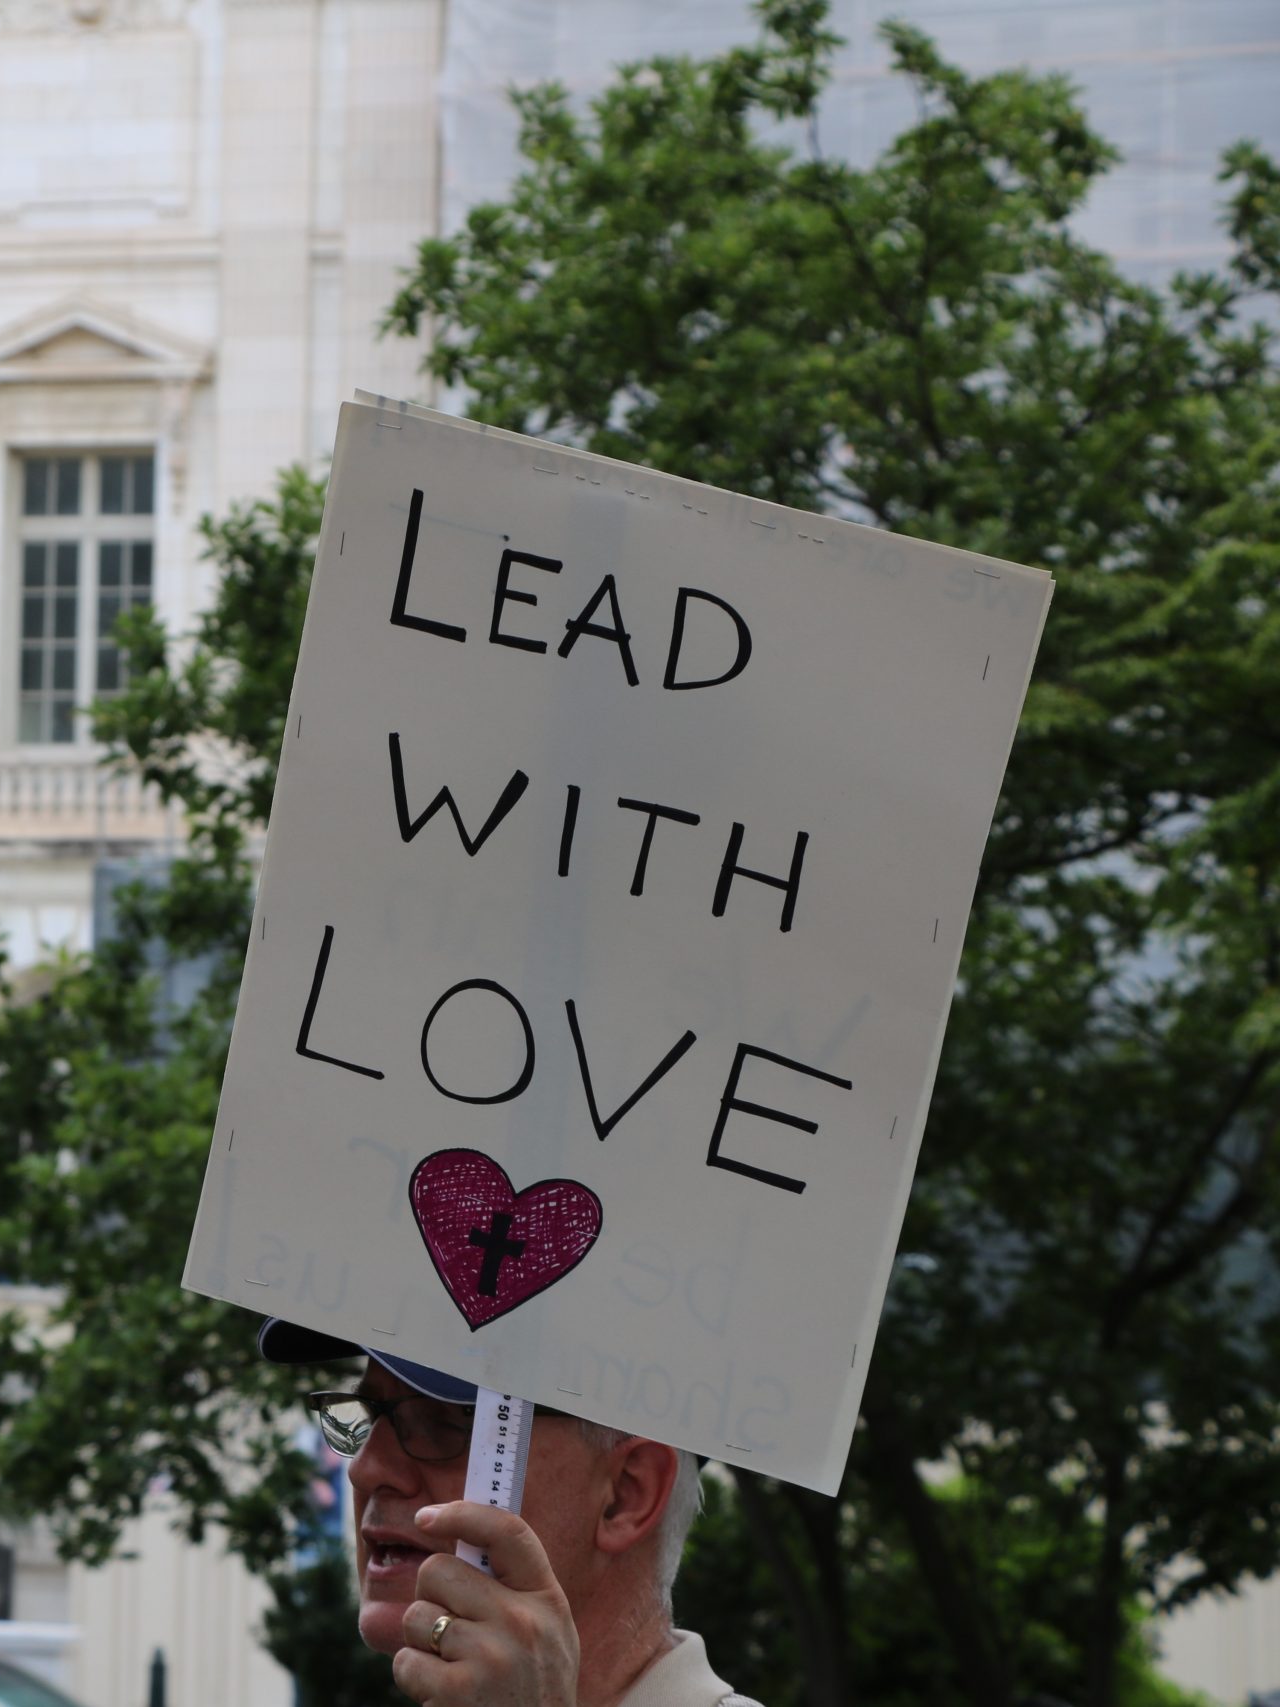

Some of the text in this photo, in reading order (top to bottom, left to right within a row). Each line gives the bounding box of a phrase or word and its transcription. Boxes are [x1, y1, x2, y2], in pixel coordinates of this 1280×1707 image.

[389, 488, 752, 691] LEAD
[388, 732, 809, 932] WITH
[296, 925, 852, 1194] LOVE
[497, 1404, 510, 1421] 50
[498, 1425, 507, 1437] 51
[496, 1443, 505, 1455] 52
[494, 1461, 502, 1473] 53
[491, 1480, 500, 1492] 54
